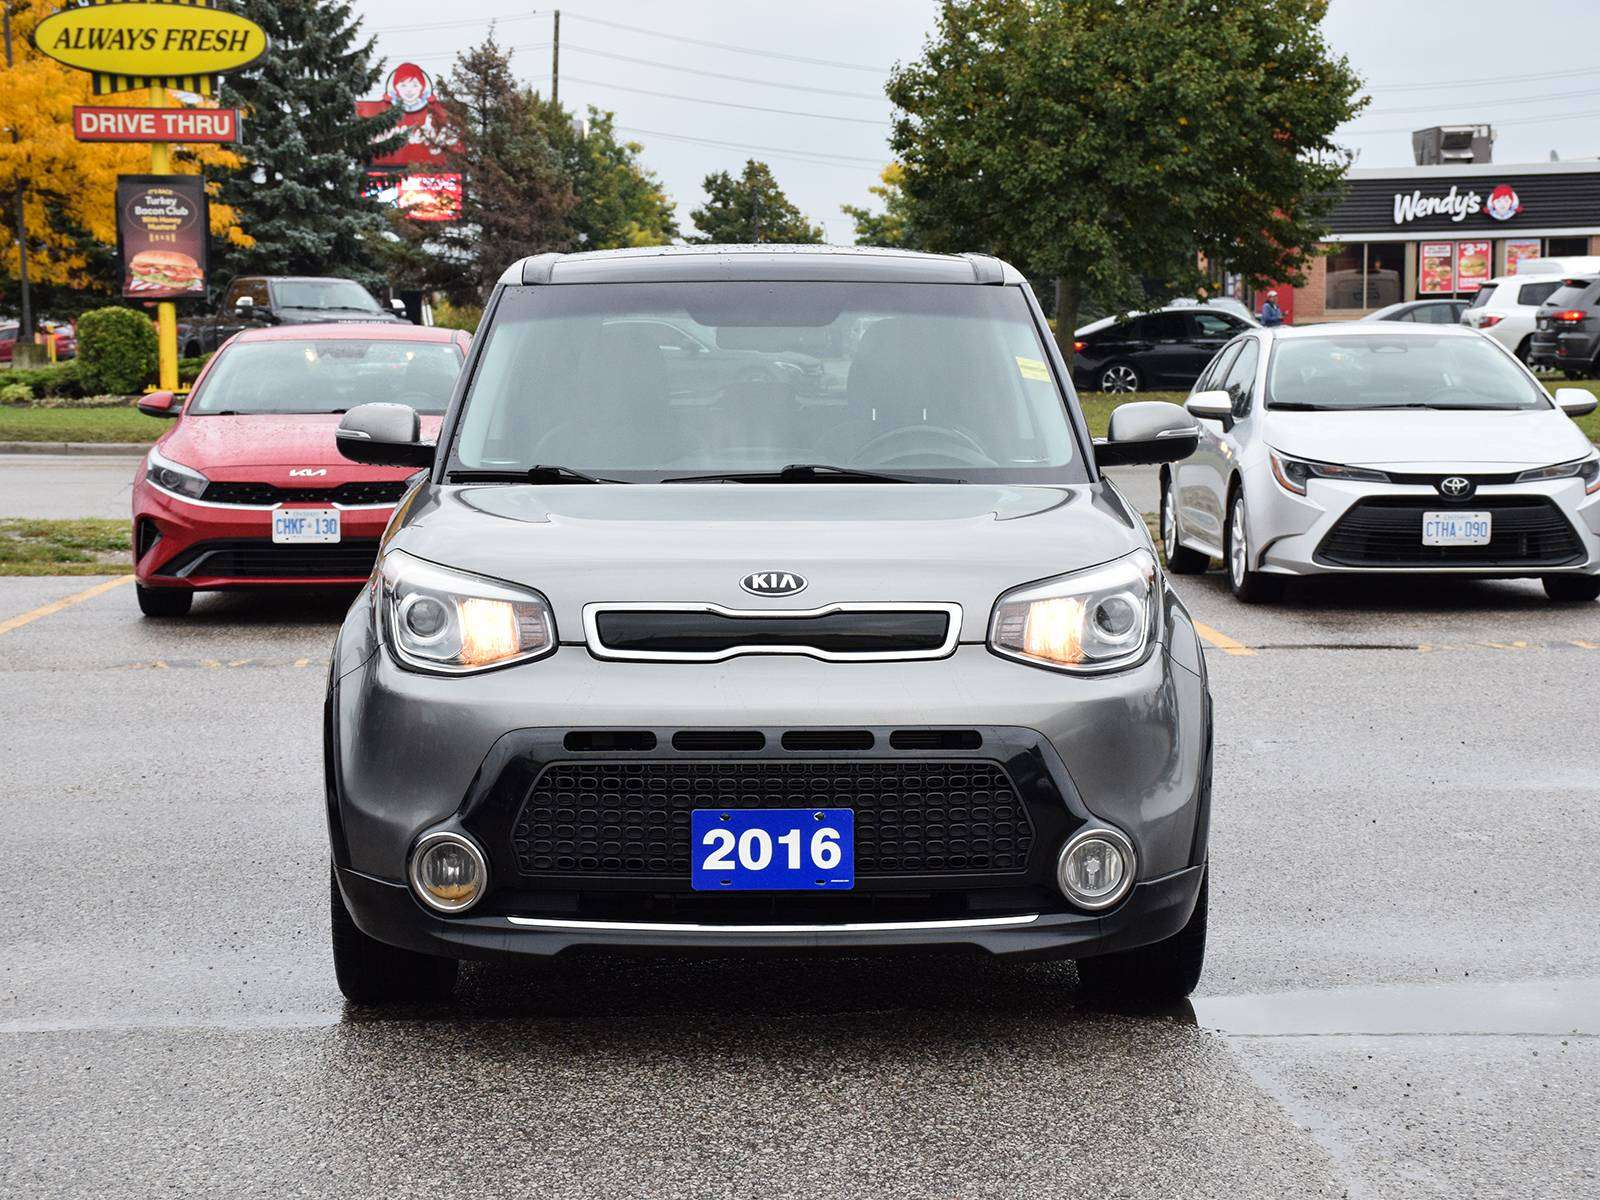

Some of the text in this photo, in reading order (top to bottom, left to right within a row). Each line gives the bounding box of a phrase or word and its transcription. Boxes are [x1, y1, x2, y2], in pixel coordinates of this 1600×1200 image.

[53, 27, 250, 51] ALWAYS FRESH
[80, 113, 230, 135] DRIVE THRU
[134, 206, 189, 216] Bacon Club
[145, 196, 177, 207] Turkey
[1393, 185, 1482, 225] Wendy's
[314, 518, 337, 535] 130
[751, 573, 797, 589] KIA
[702, 827, 842, 871] 2016
